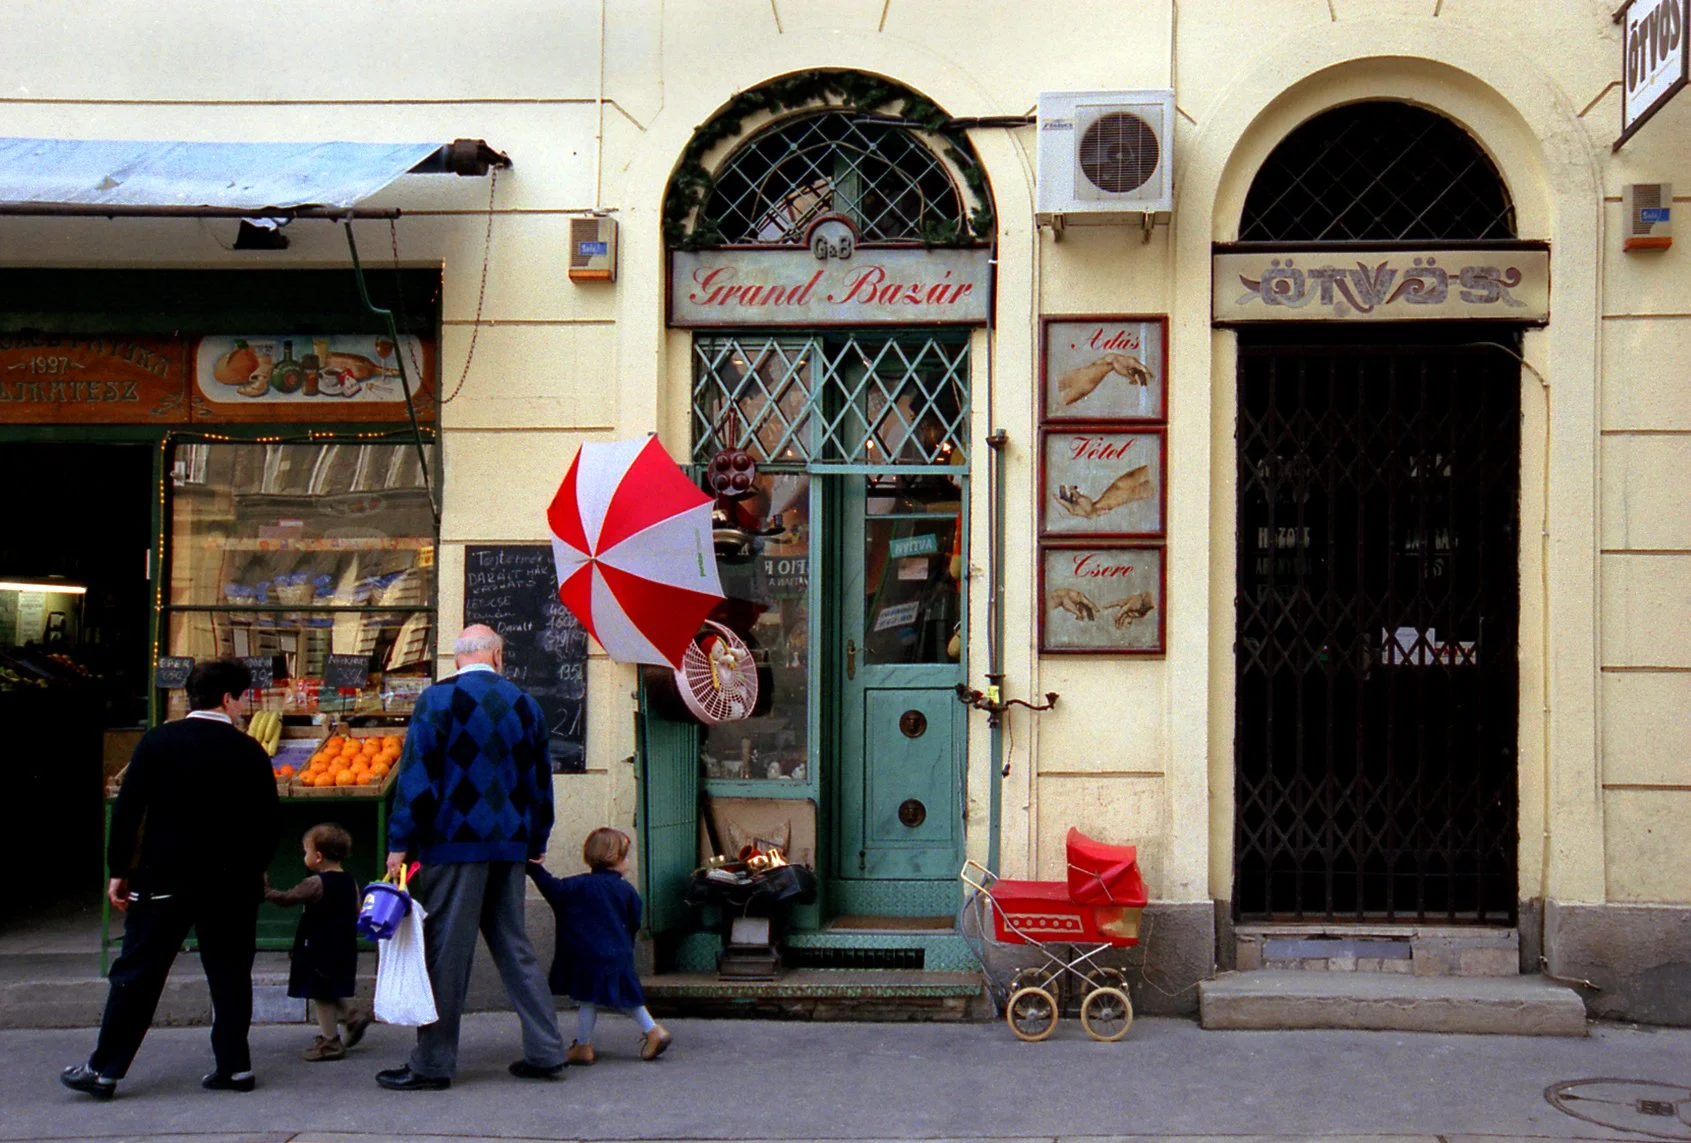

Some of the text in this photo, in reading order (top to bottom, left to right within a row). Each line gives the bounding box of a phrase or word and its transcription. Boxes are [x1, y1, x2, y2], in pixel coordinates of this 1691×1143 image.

[689, 264, 973, 306] Grand Bazár
[1256, 257, 1504, 306] ÖTVÖS
[1071, 328, 1140, 350] Adás
[31, 356, 69, 375] 1997
[1070, 436, 1136, 460] Vétel
[1073, 553, 1136, 578] Csere
